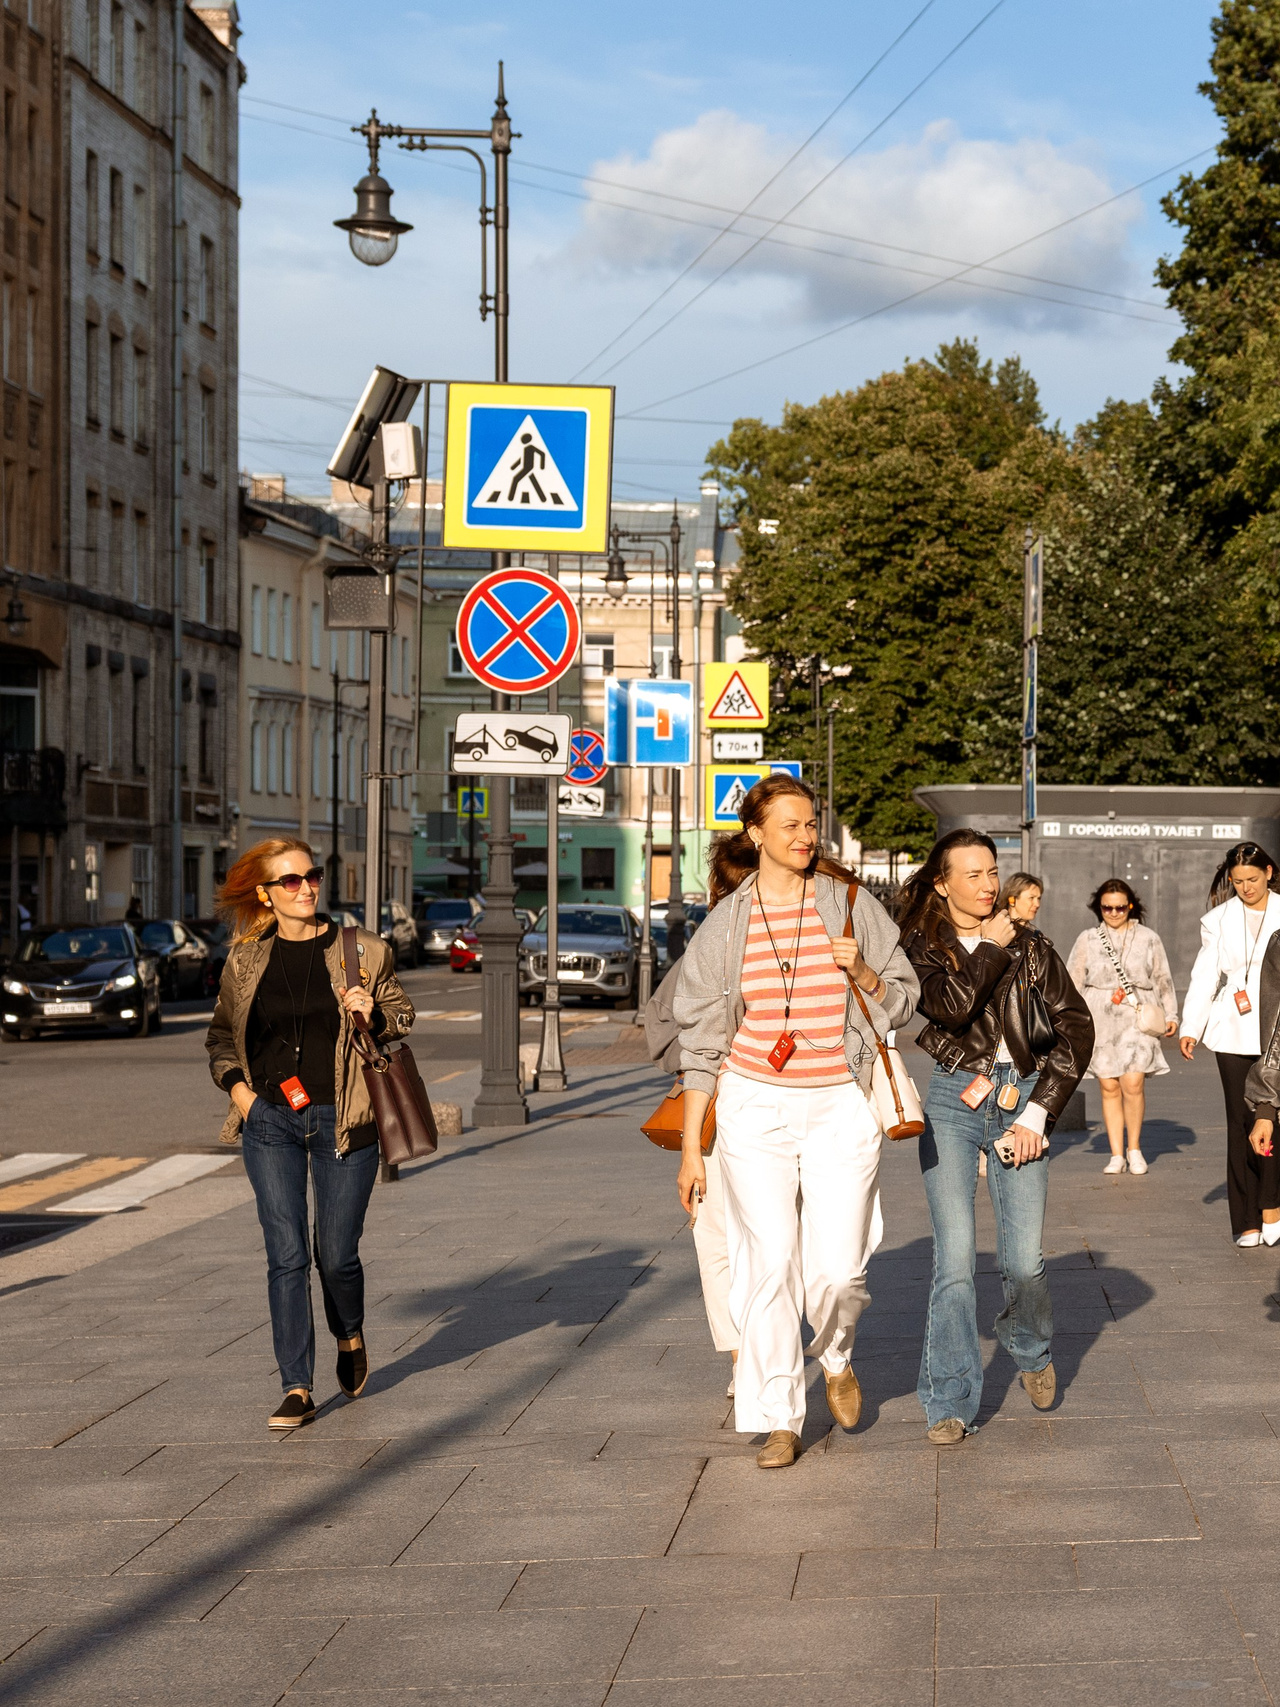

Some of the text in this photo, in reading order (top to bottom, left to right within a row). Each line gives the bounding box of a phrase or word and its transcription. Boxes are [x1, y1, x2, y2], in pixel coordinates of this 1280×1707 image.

[728, 742, 748, 751] 70м
[1068, 823, 1204, 837] ГОРОДСКОЙ ТУАЛЕТ
